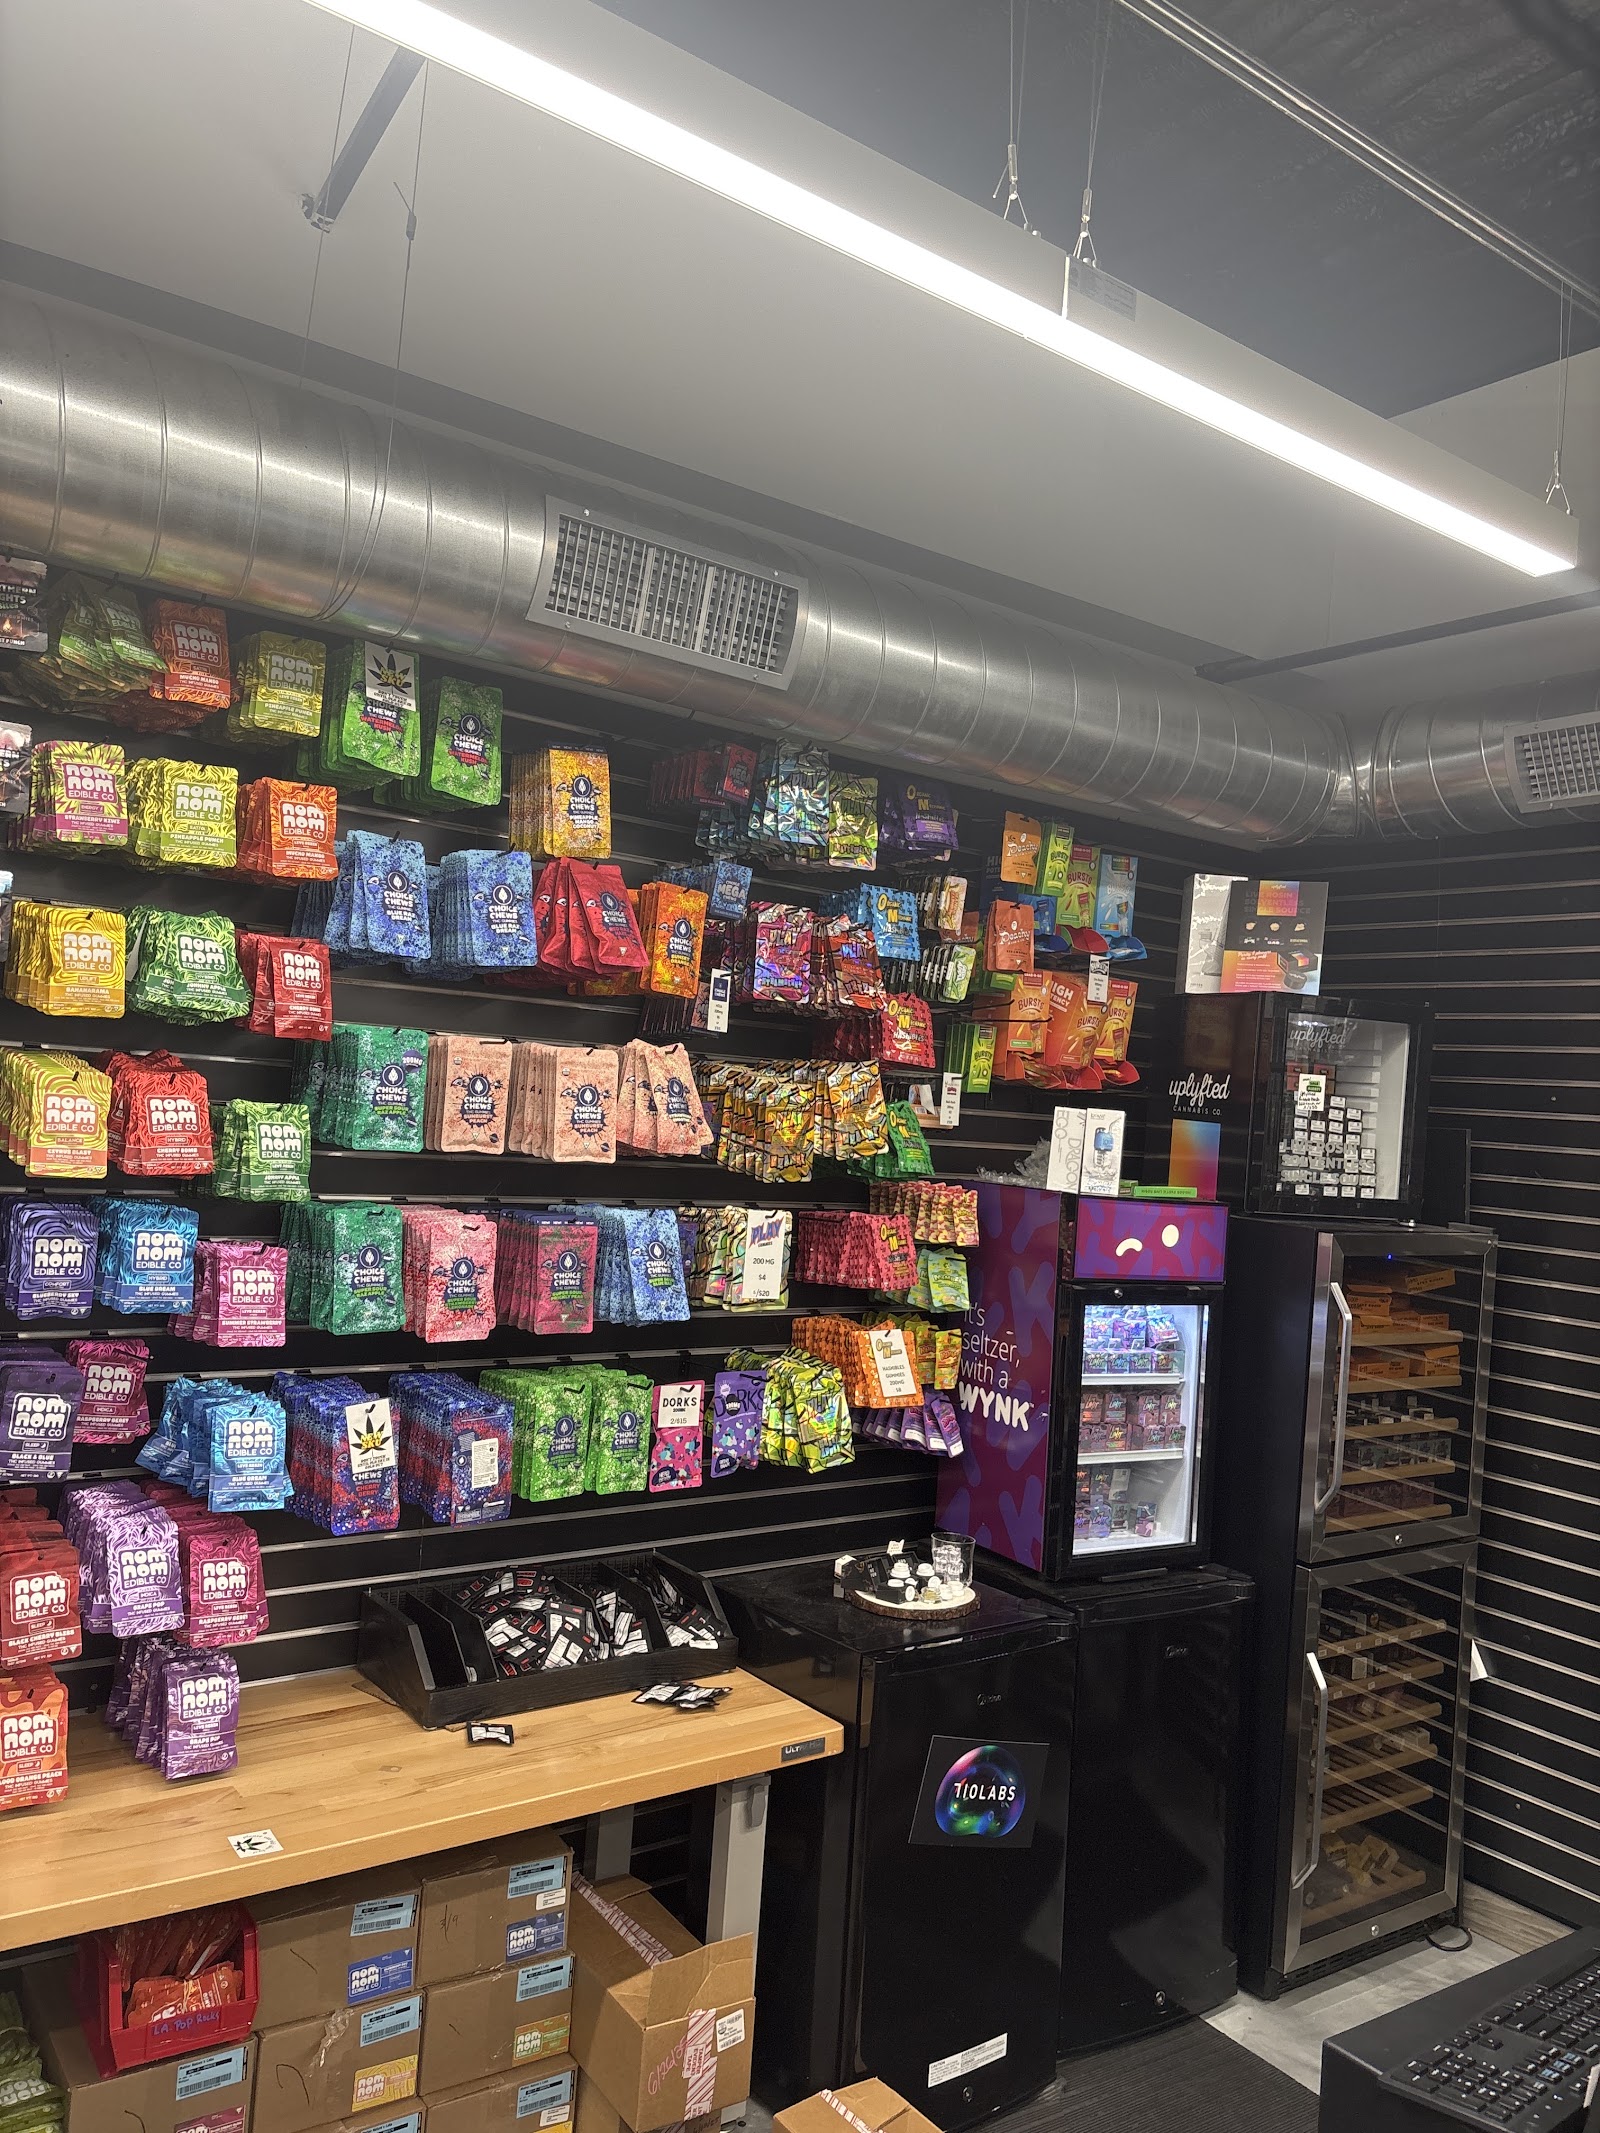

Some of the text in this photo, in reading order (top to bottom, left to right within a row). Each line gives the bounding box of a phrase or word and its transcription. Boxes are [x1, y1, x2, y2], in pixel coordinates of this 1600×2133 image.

[178, 650, 219, 663] EDIBLE CO
[68, 791, 115, 801] EDIBLE CO
[384, 898, 414, 908] CHEWS
[65, 961, 111, 971] EDIBLE CO
[376, 1087, 408, 1096] CHOICE
[1168, 1072, 1230, 1109] uplyfted
[376, 1094, 407, 1103] CHEWS
[464, 1096, 493, 1104] CHOICE
[464, 1103, 492, 1111] CHEWS
[573, 1106, 603, 1114] CHOICE
[1173, 1105, 1209, 1115] CANNABIS
[574, 1112, 602, 1120] CHEWS
[45, 1124, 95, 1133] EDIBLE CO
[152, 1123, 198, 1132] EDIBLE CO
[136, 1261, 182, 1269] EDIBLE CO
[752, 1257, 765, 1265] 200
[34, 1267, 82, 1276] EDIBLE CO
[353, 1267, 385, 1277] CHOICE
[553, 1272, 582, 1280] CHOICE
[354, 1275, 385, 1284] CHEWS
[553, 1278, 581, 1286] CHEWS
[961, 1328, 1020, 1368] seltzer,
[960, 1356, 1009, 1389] with a
[84, 1393, 128, 1402] EDIBLE CO
[662, 1397, 698, 1408] DORKS
[958, 1381, 1030, 1432] WYNK
[12, 1428, 62, 1437] EDIBLE CO
[352, 1470, 382, 1481] CHEWS
[124, 1576, 167, 1588] EDIBLE CO
[15, 1604, 65, 1620] EDIBLE CO
[4, 1744, 53, 1760] EDIBLE CO
